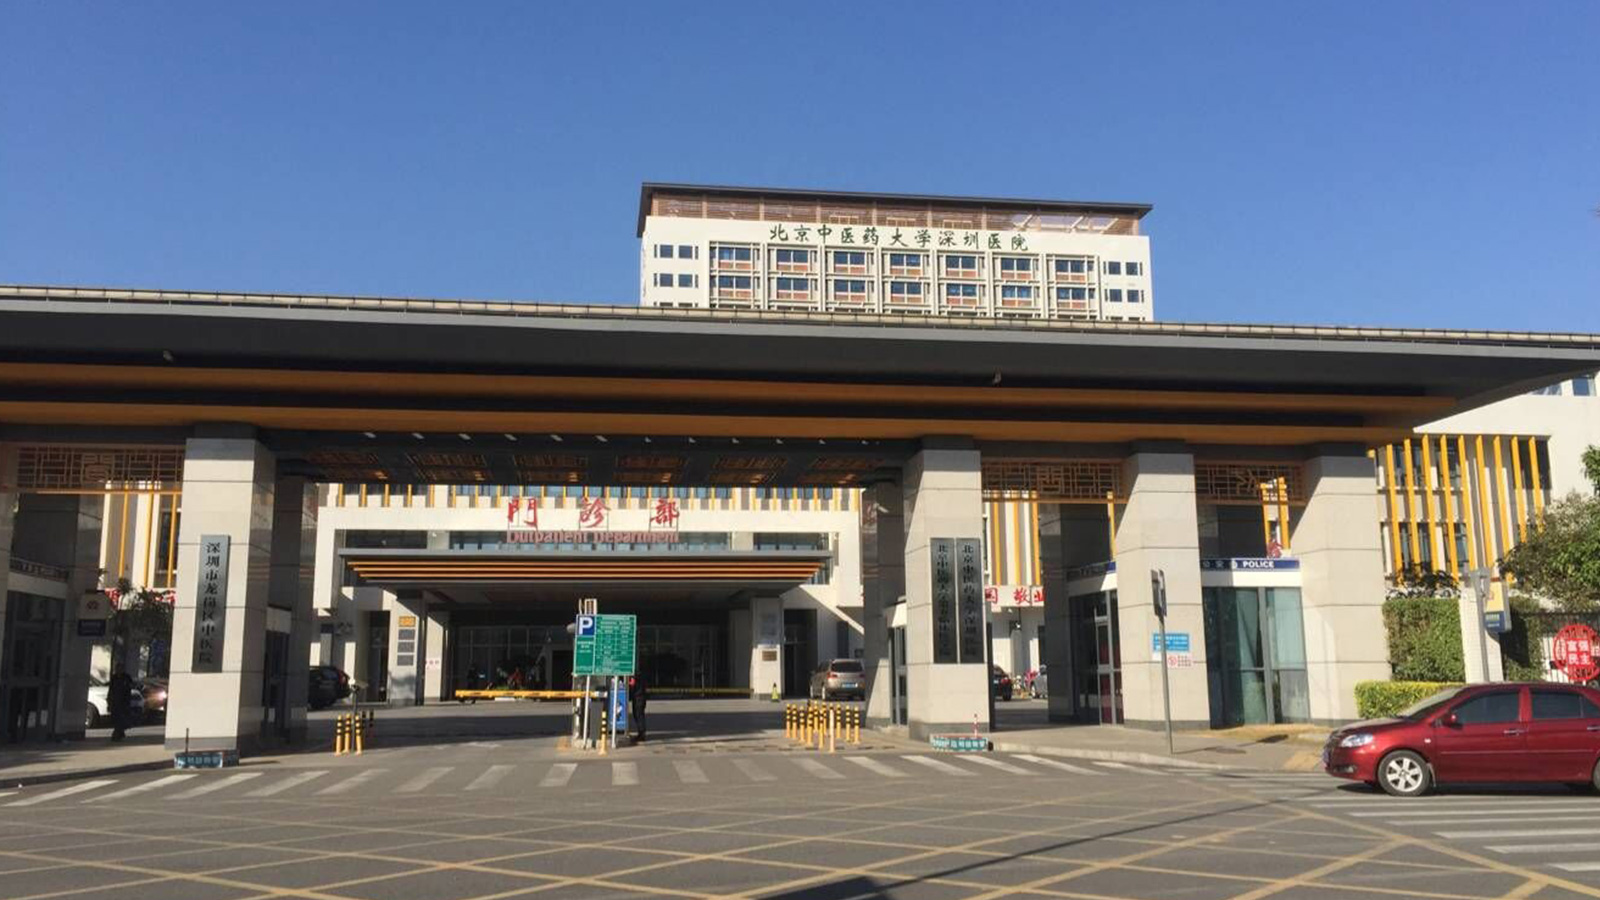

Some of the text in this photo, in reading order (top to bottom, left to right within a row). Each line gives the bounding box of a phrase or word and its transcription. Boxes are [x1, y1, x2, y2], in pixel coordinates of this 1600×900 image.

[770, 224, 1028, 251] 北京中医药大学深圳医院
[508, 496, 680, 529] 門診部
[507, 530, 679, 544] Outpatient Department
[1242, 560, 1274, 568] POLICE
[578, 616, 593, 635] P
[1568, 652, 1590, 665] 民主
